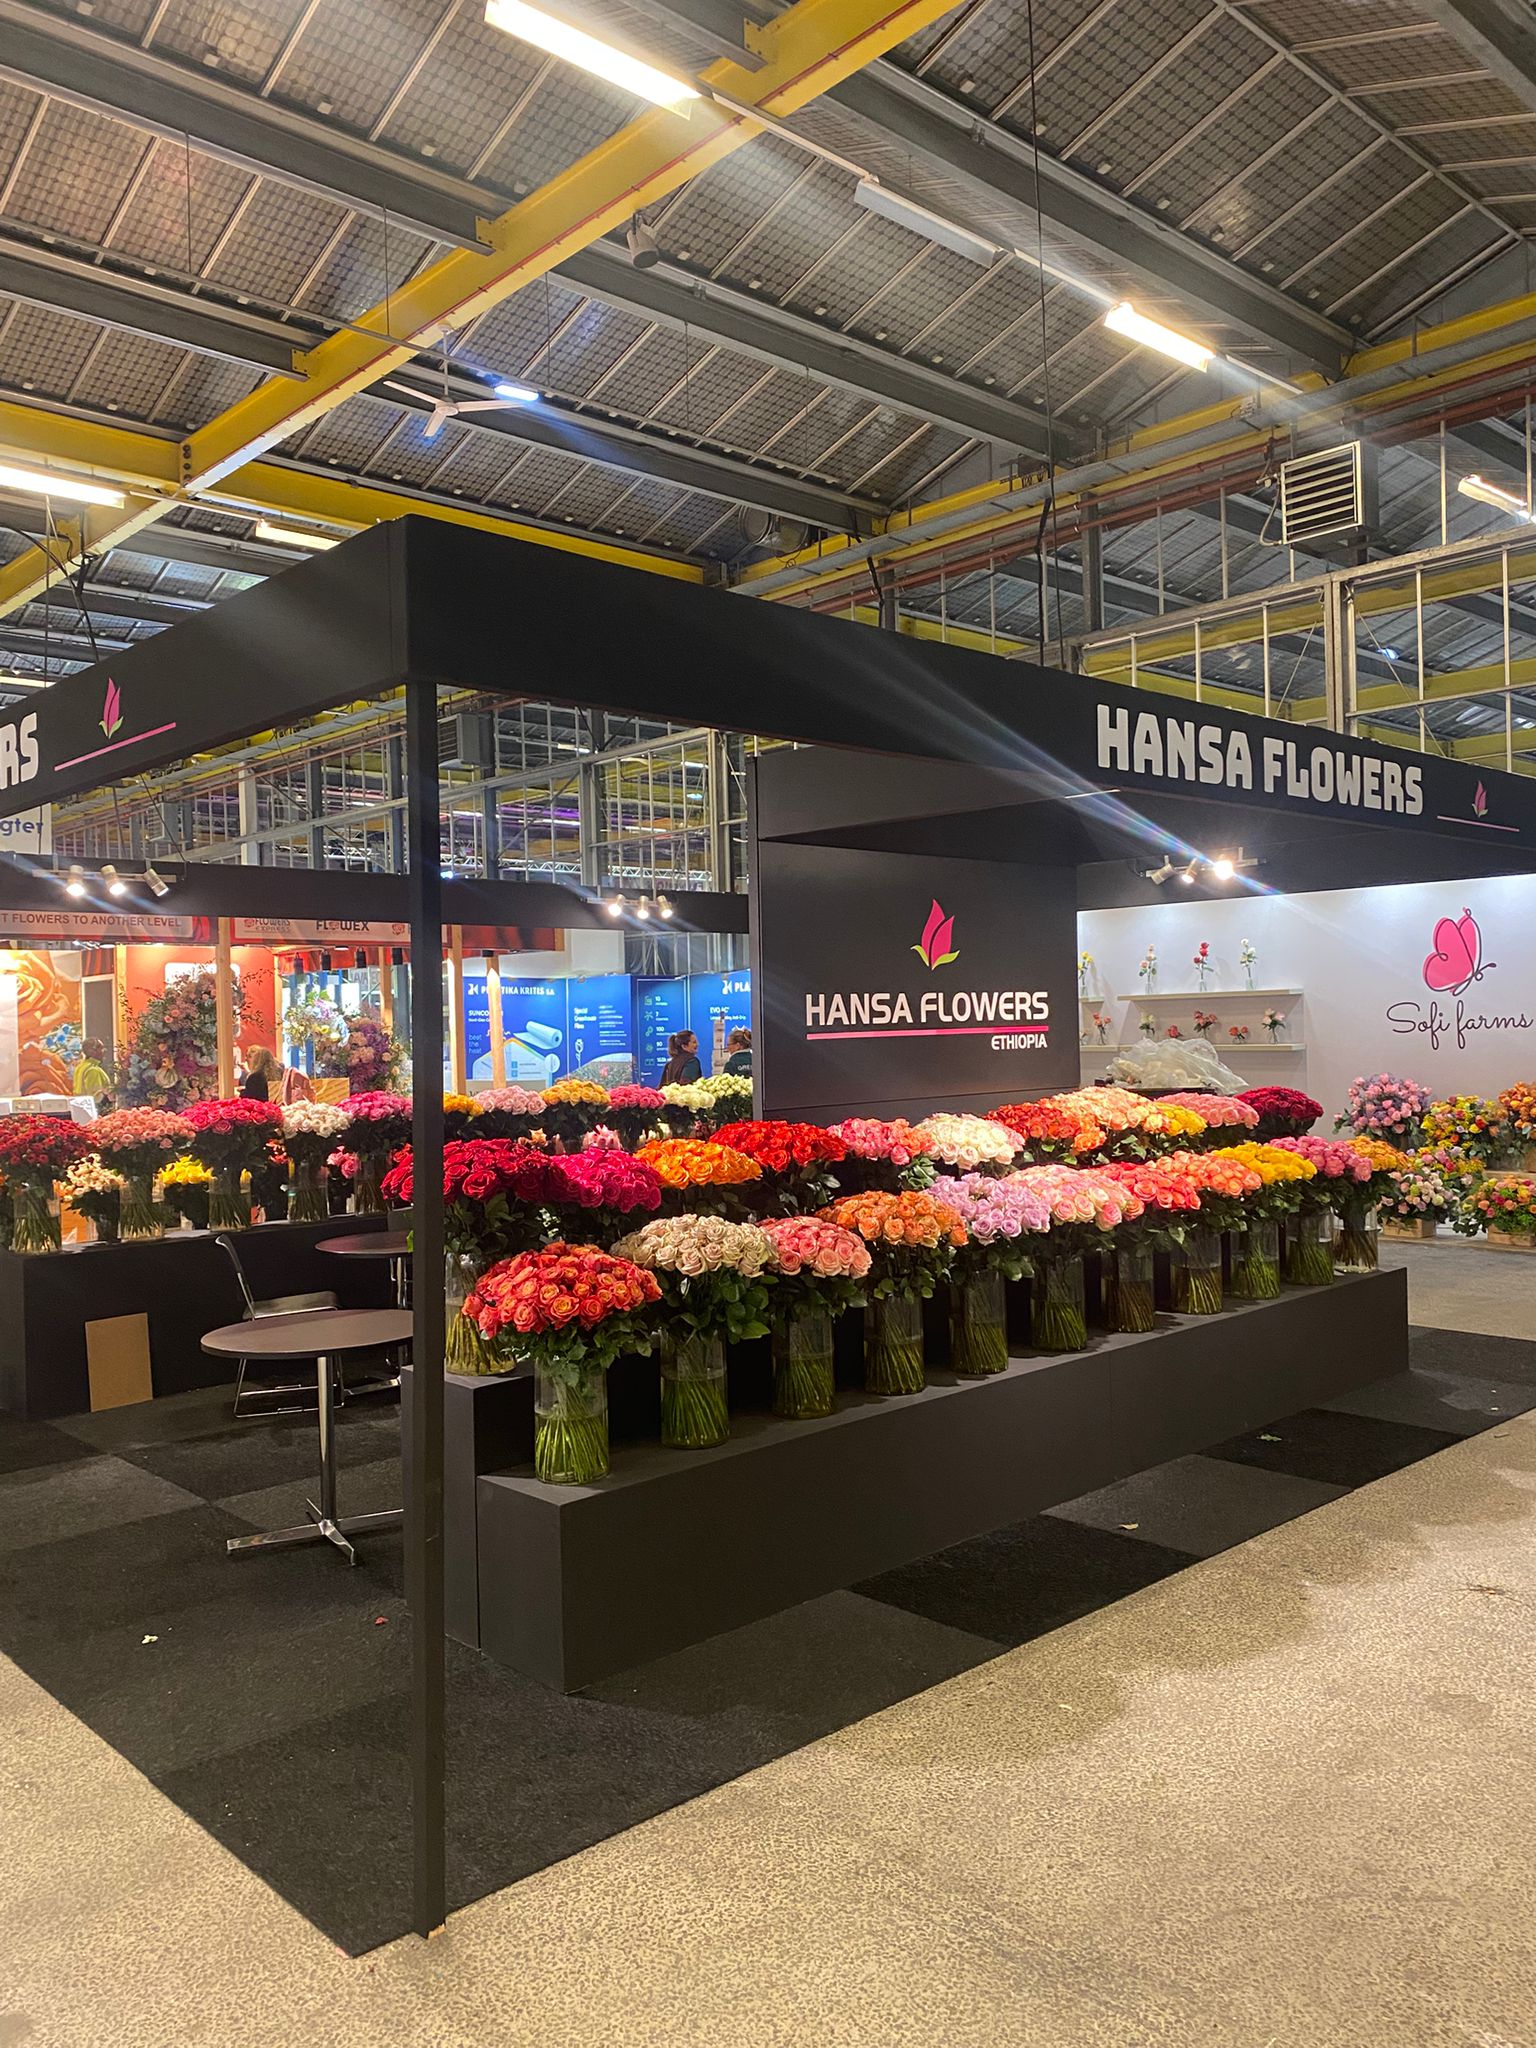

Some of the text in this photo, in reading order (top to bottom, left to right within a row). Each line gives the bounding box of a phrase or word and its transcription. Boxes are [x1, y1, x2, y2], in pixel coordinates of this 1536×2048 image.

[1096, 703, 1424, 816] HANSA FLOWERS
[12, 913, 70, 924] FLOWERS
[73, 914, 88, 925] TO
[91, 914, 145, 926] ANOTHER
[148, 917, 182, 927] LEVEL
[520, 986, 545, 996] KRITIS
[805, 991, 1049, 1026] HANSA FLOWERS
[1386, 1000, 1534, 1050] Sofi farms
[991, 1034, 1047, 1050] ETHIOPIA
